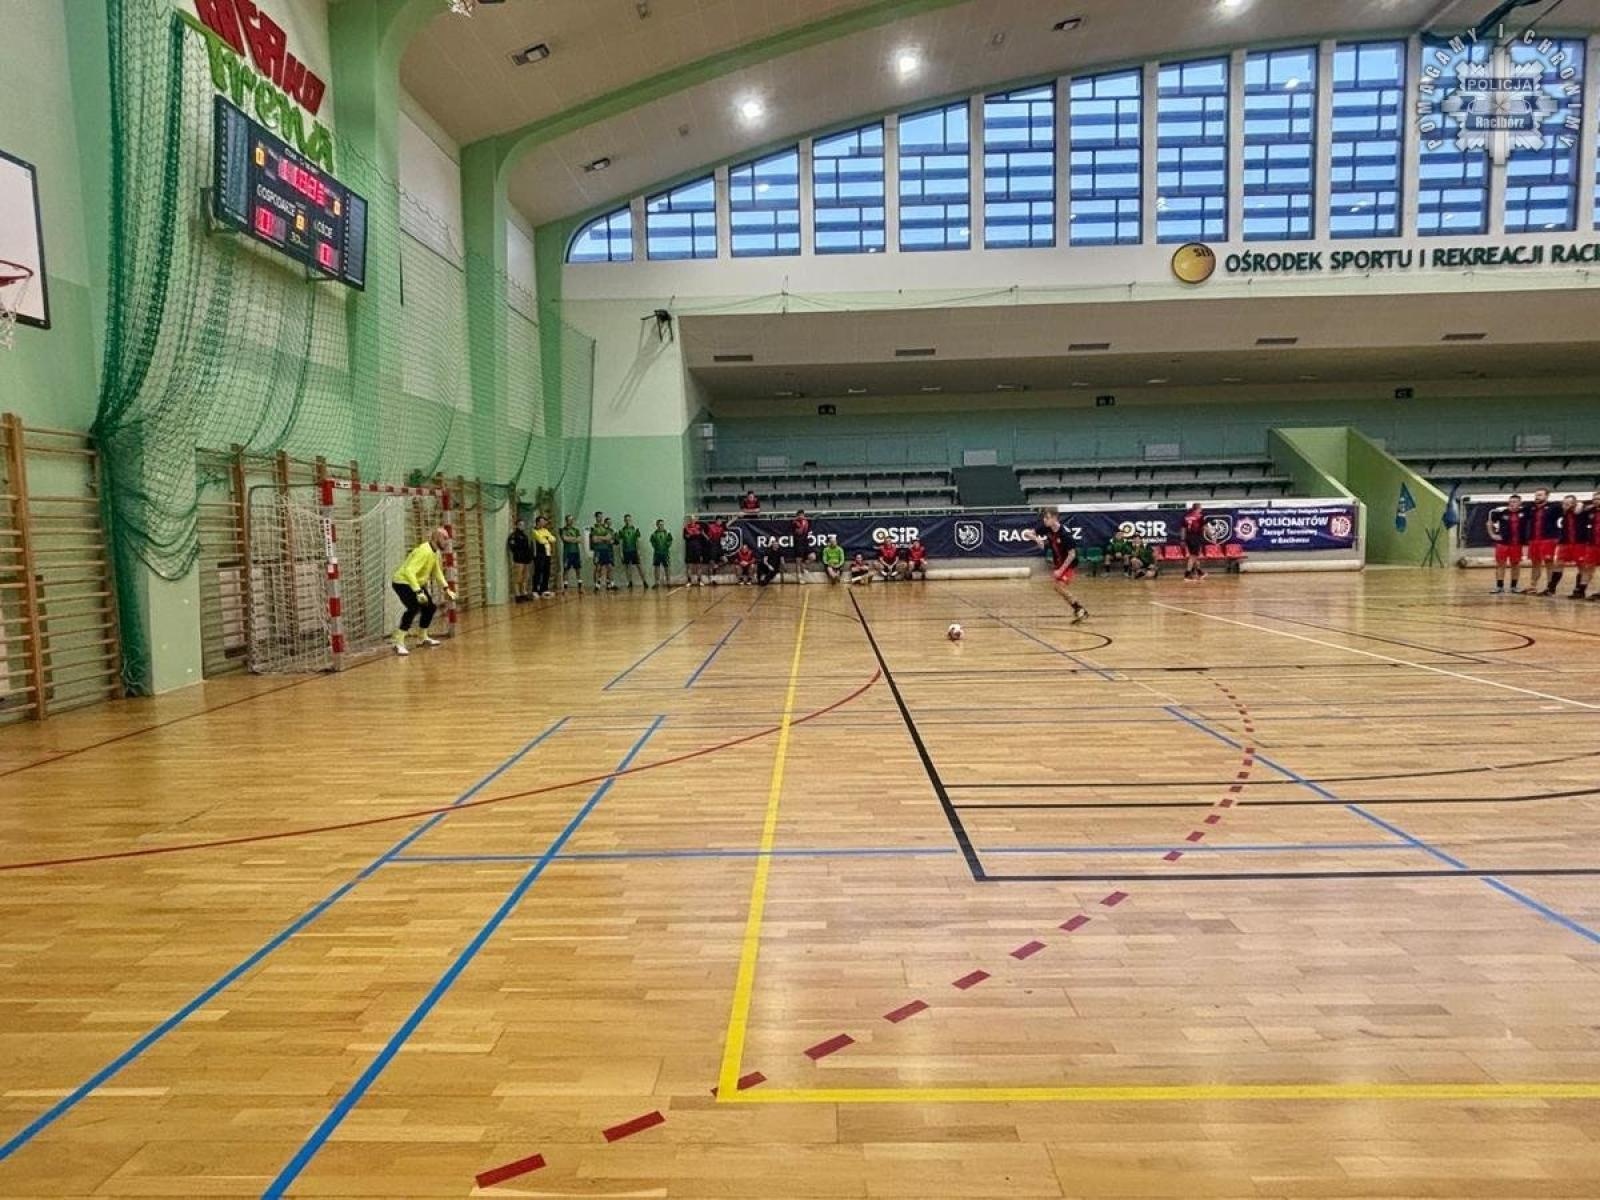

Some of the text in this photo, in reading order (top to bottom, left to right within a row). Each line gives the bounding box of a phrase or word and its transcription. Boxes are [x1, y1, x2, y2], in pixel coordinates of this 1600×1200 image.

[1225, 249, 1323, 273] OŚRODEK
[1330, 249, 1413, 270] SPORTU
[1419, 249, 1425, 267] I
[1432, 245, 1544, 267] REKREACJI
[1118, 520, 1168, 537] OSiR
[1258, 516, 1328, 526] POLICJANTÓW
[756, 531, 837, 548] RACIÓR
[872, 527, 920, 544] OSiR
[998, 527, 1083, 542] RACZ
